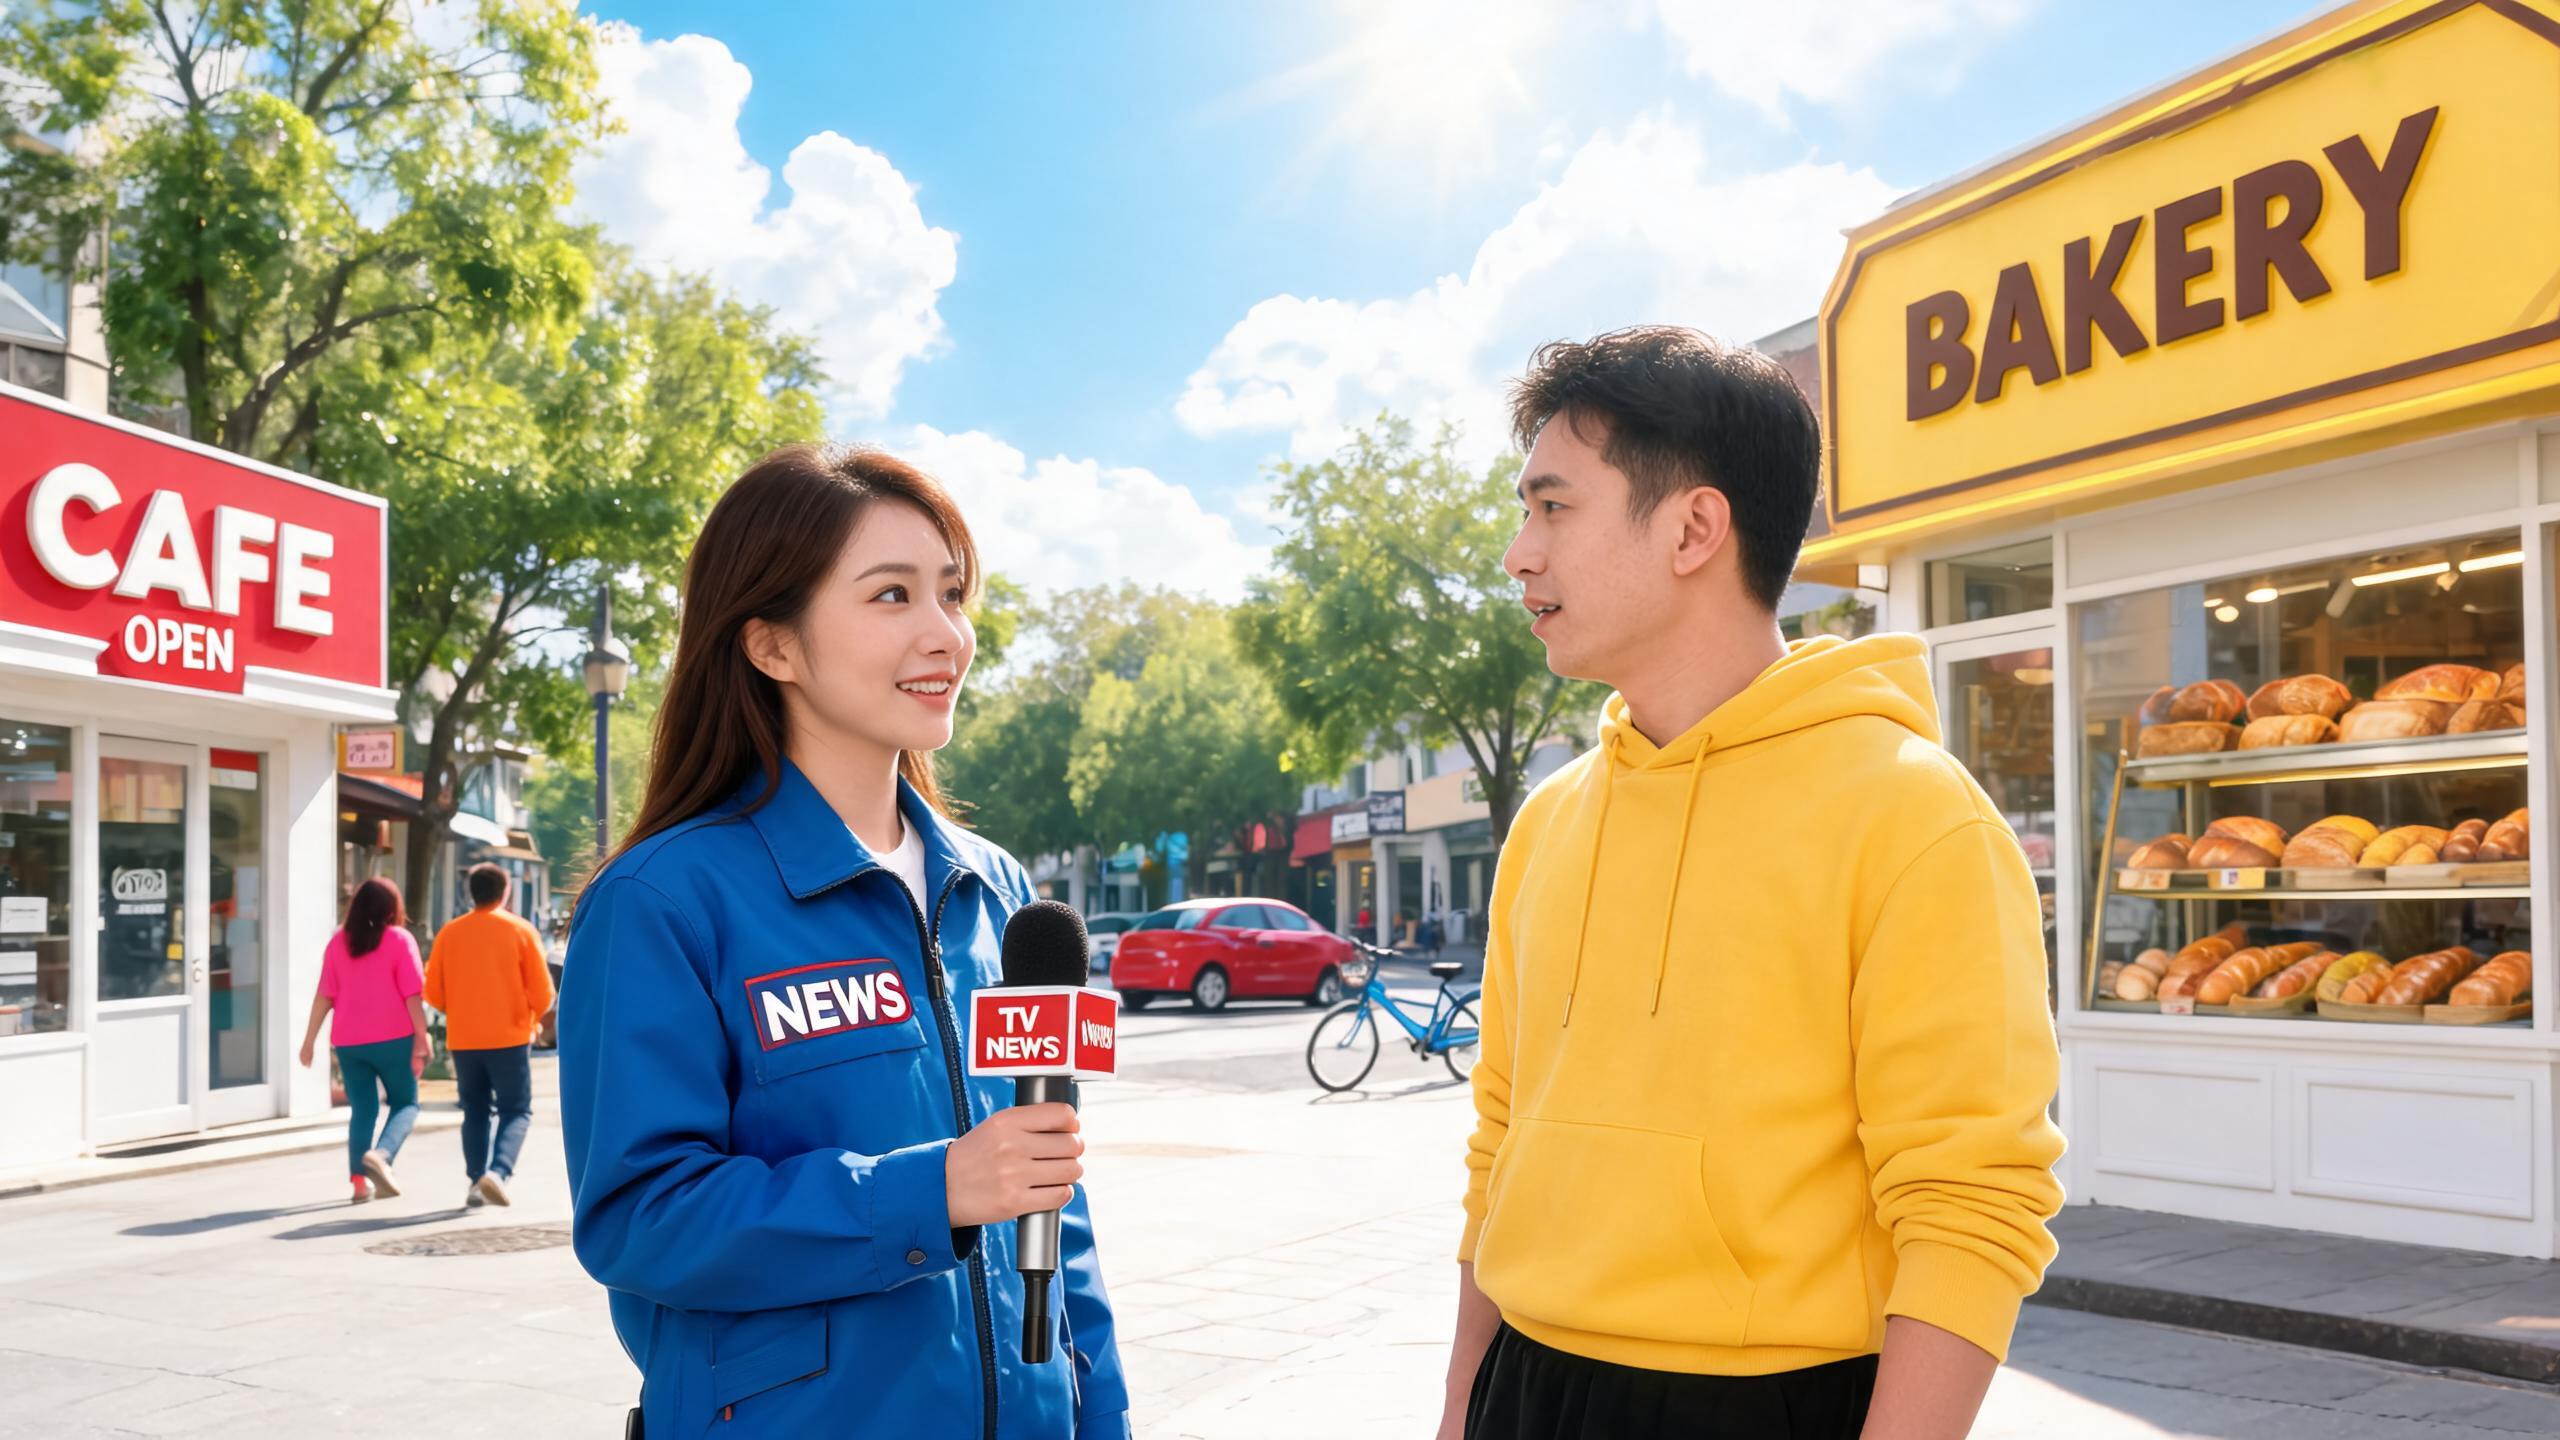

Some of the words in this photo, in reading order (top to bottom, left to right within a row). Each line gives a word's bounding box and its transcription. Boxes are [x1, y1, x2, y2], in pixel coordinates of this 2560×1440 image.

[1906, 105, 2440, 421] BAKERY
[26, 462, 334, 636] CAFE
[124, 615, 235, 673] OPEN
[761, 971, 906, 1042] NEWS
[998, 1005, 1040, 1033] TV
[986, 1036, 1060, 1060] NEWS
